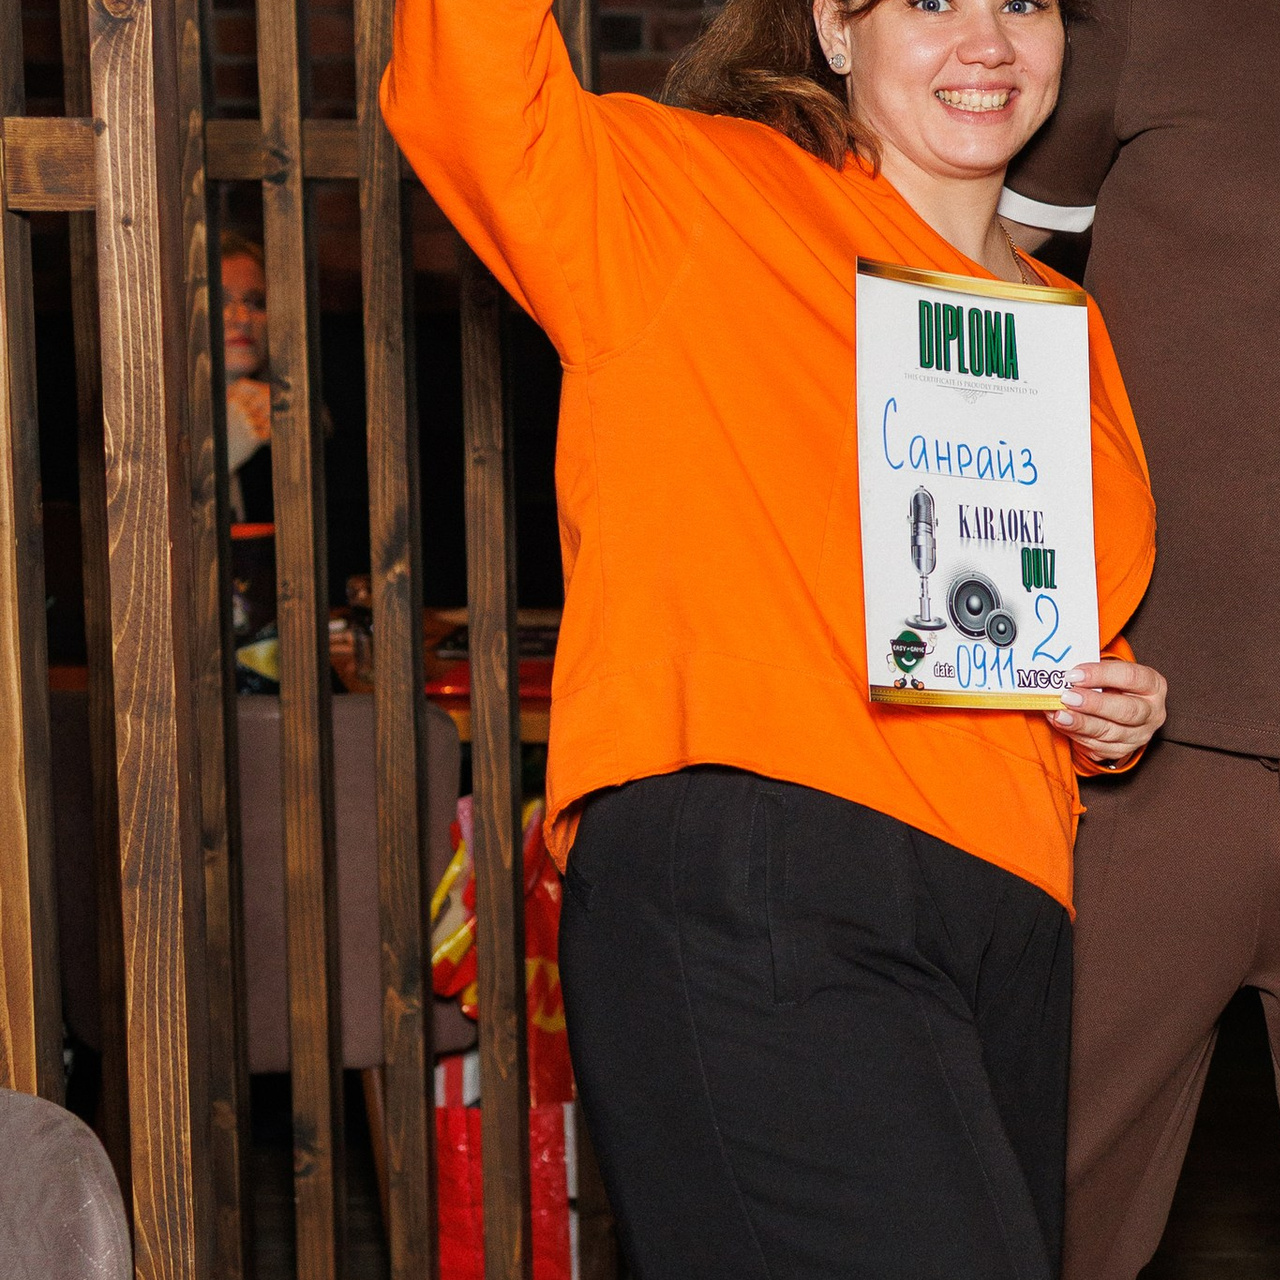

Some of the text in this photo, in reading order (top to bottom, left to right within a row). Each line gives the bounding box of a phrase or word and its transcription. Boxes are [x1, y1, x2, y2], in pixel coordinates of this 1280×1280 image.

[919, 300, 1019, 380] DIPLOMA
[904, 372, 918, 381] THIS
[919, 374, 956, 387] CERTIFICATE
[964, 380, 991, 391] PROUDLY
[993, 383, 1028, 395] PRESENTED
[1028, 387, 1039, 396] TO
[881, 397, 1038, 486] Санрайз
[957, 504, 1045, 544] KARAOKE
[1021, 547, 1058, 592] QUIZ
[1032, 594, 1073, 664] 2
[933, 661, 956, 678] data
